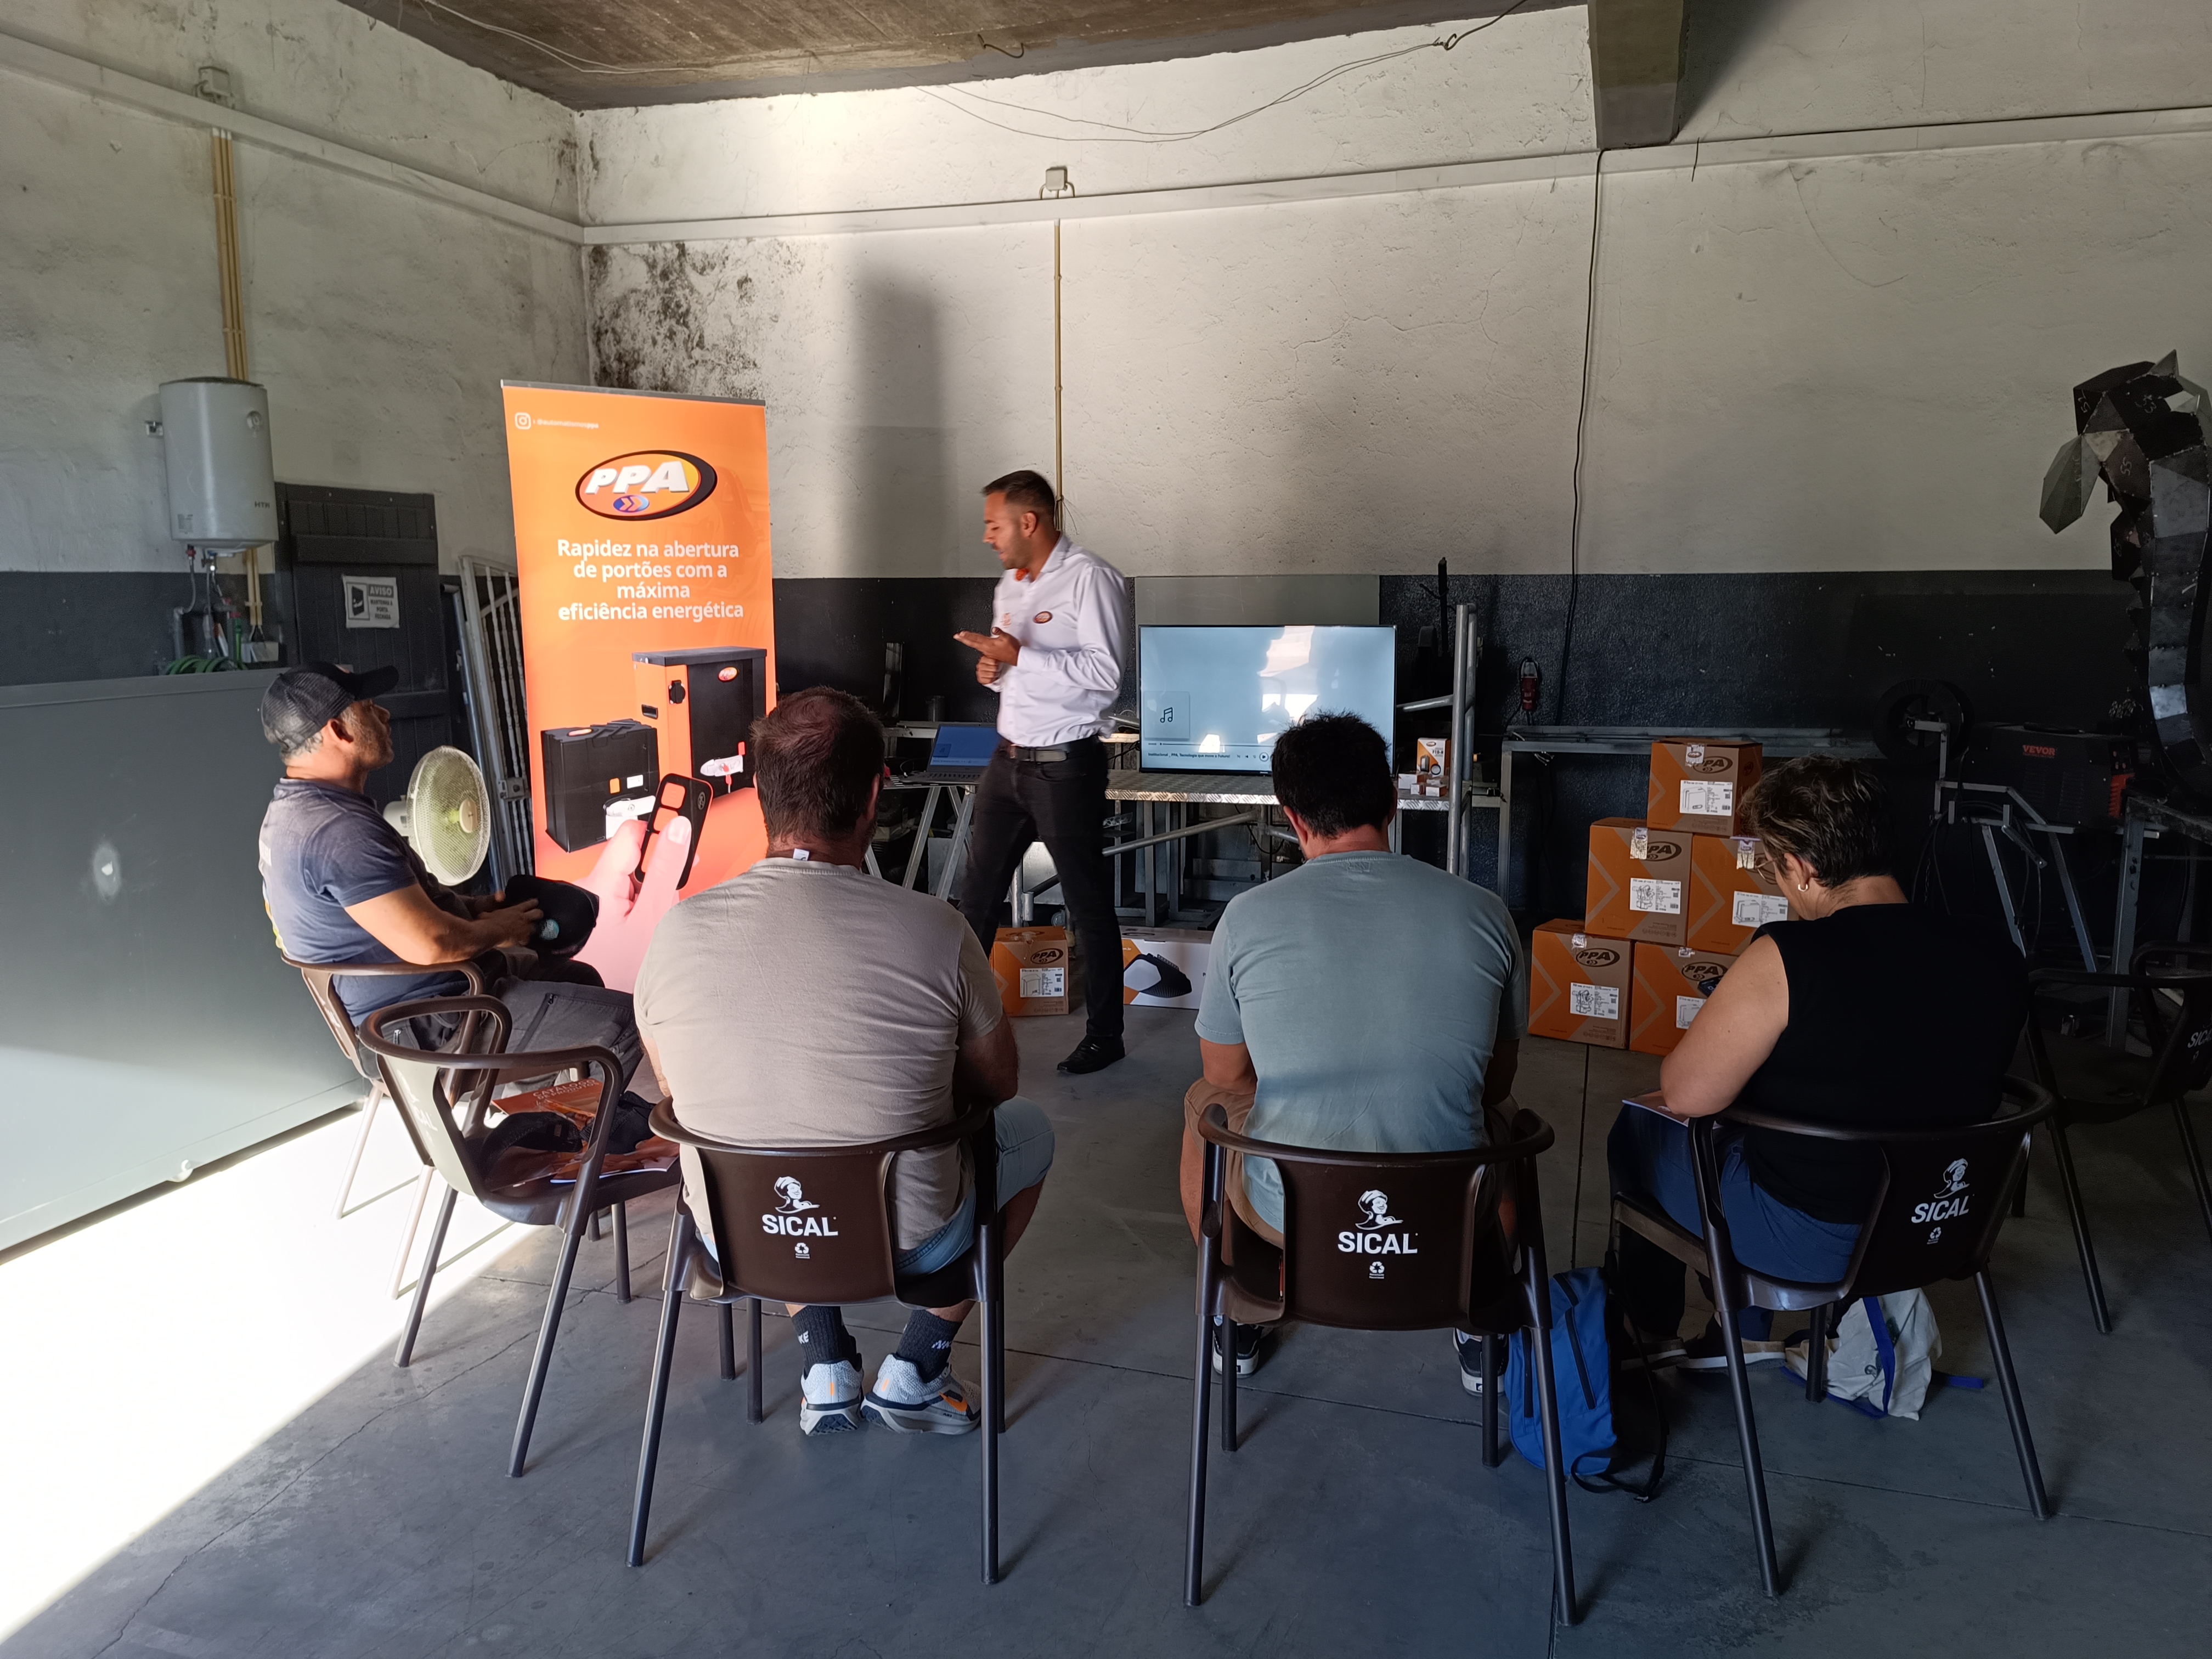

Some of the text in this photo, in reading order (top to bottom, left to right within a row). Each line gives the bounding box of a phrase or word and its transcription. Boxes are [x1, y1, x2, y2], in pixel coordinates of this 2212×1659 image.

[584, 460, 690, 495] PPA
[557, 539, 739, 561] Rapidez na abertura
[573, 561, 727, 583] de portões com a
[370, 586, 392, 596] AVISO
[617, 582, 690, 599] máxima
[558, 601, 744, 623] eficiência energética
[2023, 744, 2055, 756] VEVOR
[1647, 845, 1672, 854] PA
[1032, 950, 1057, 960] PPA
[1579, 951, 1611, 961] PPA
[1684, 966, 1719, 975] PPA
[1911, 1195, 1970, 1224] SICAL
[761, 1214, 839, 1237] SICAL
[1338, 1231, 1418, 1254] SICAL
